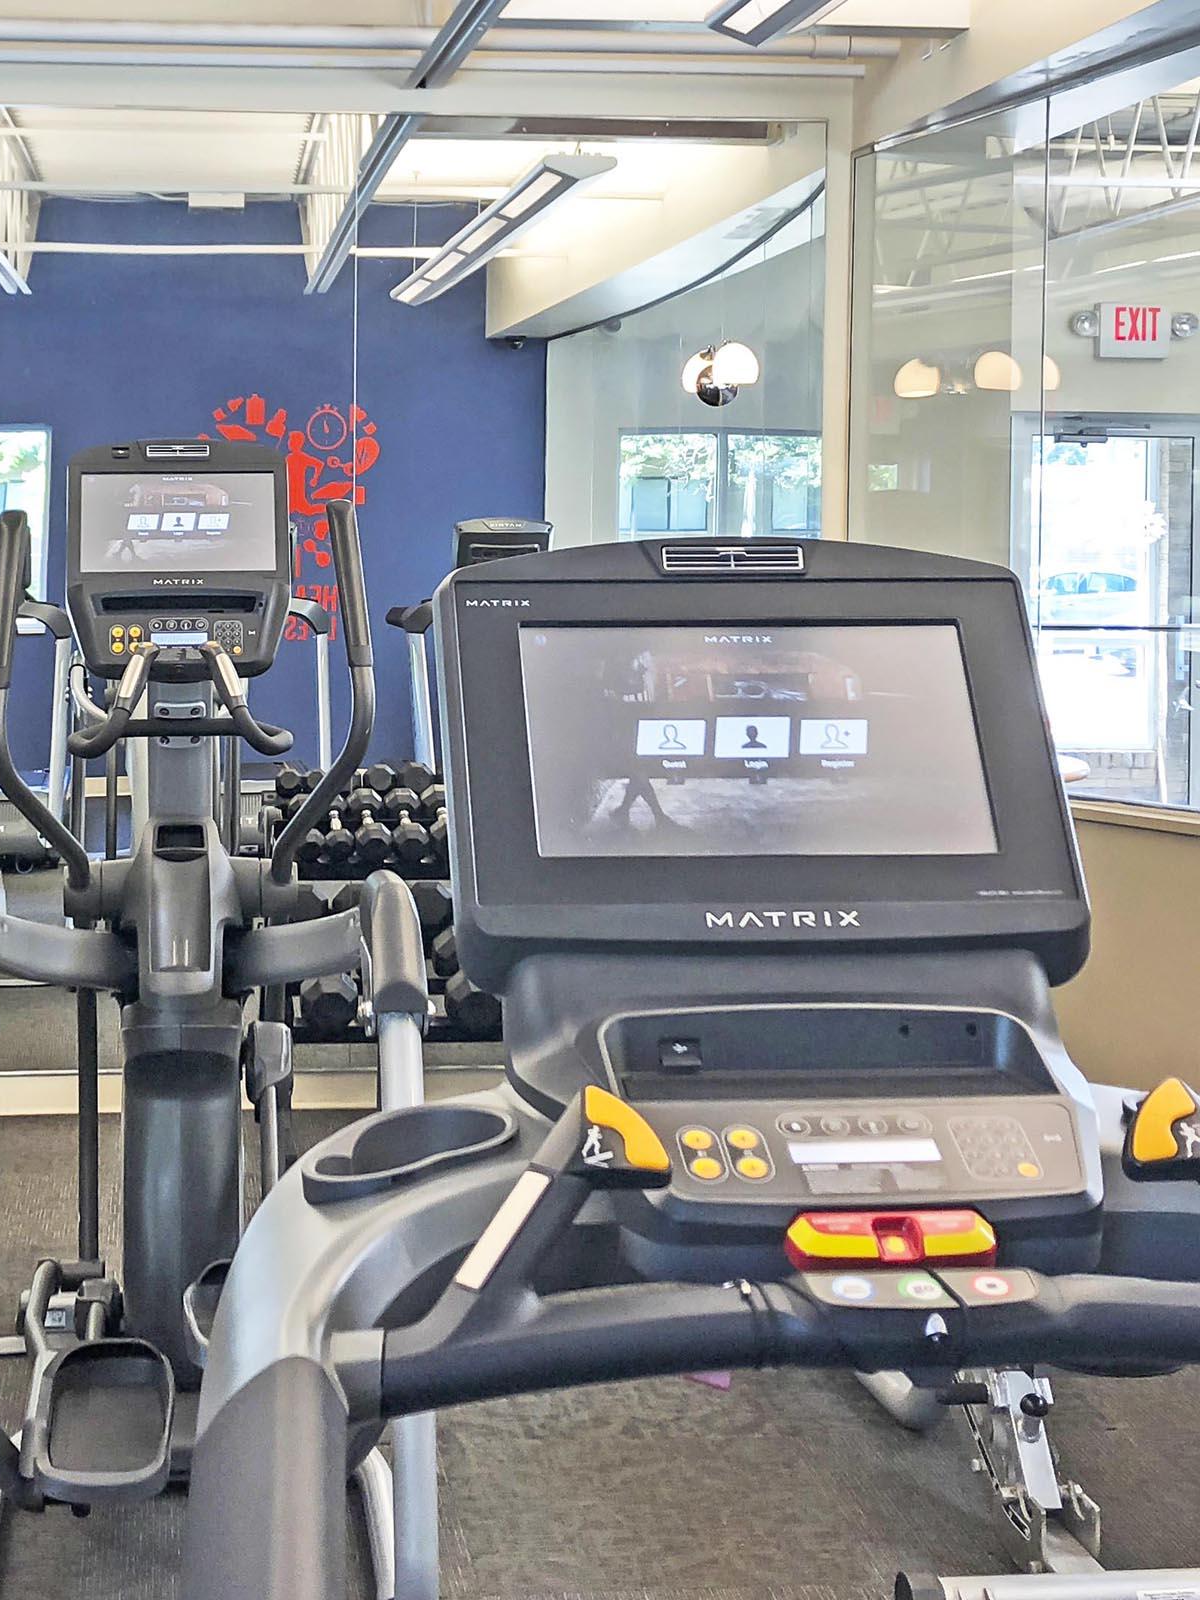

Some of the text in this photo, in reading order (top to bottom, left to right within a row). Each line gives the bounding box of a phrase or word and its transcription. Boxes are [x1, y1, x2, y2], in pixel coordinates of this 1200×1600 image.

[1114, 306, 1161, 342] EXIT
[152, 578, 205, 586] MATRIX
[465, 599, 531, 608] MATRIX
[704, 635, 773, 644] MATRIX
[704, 909, 862, 928] MATRIX
